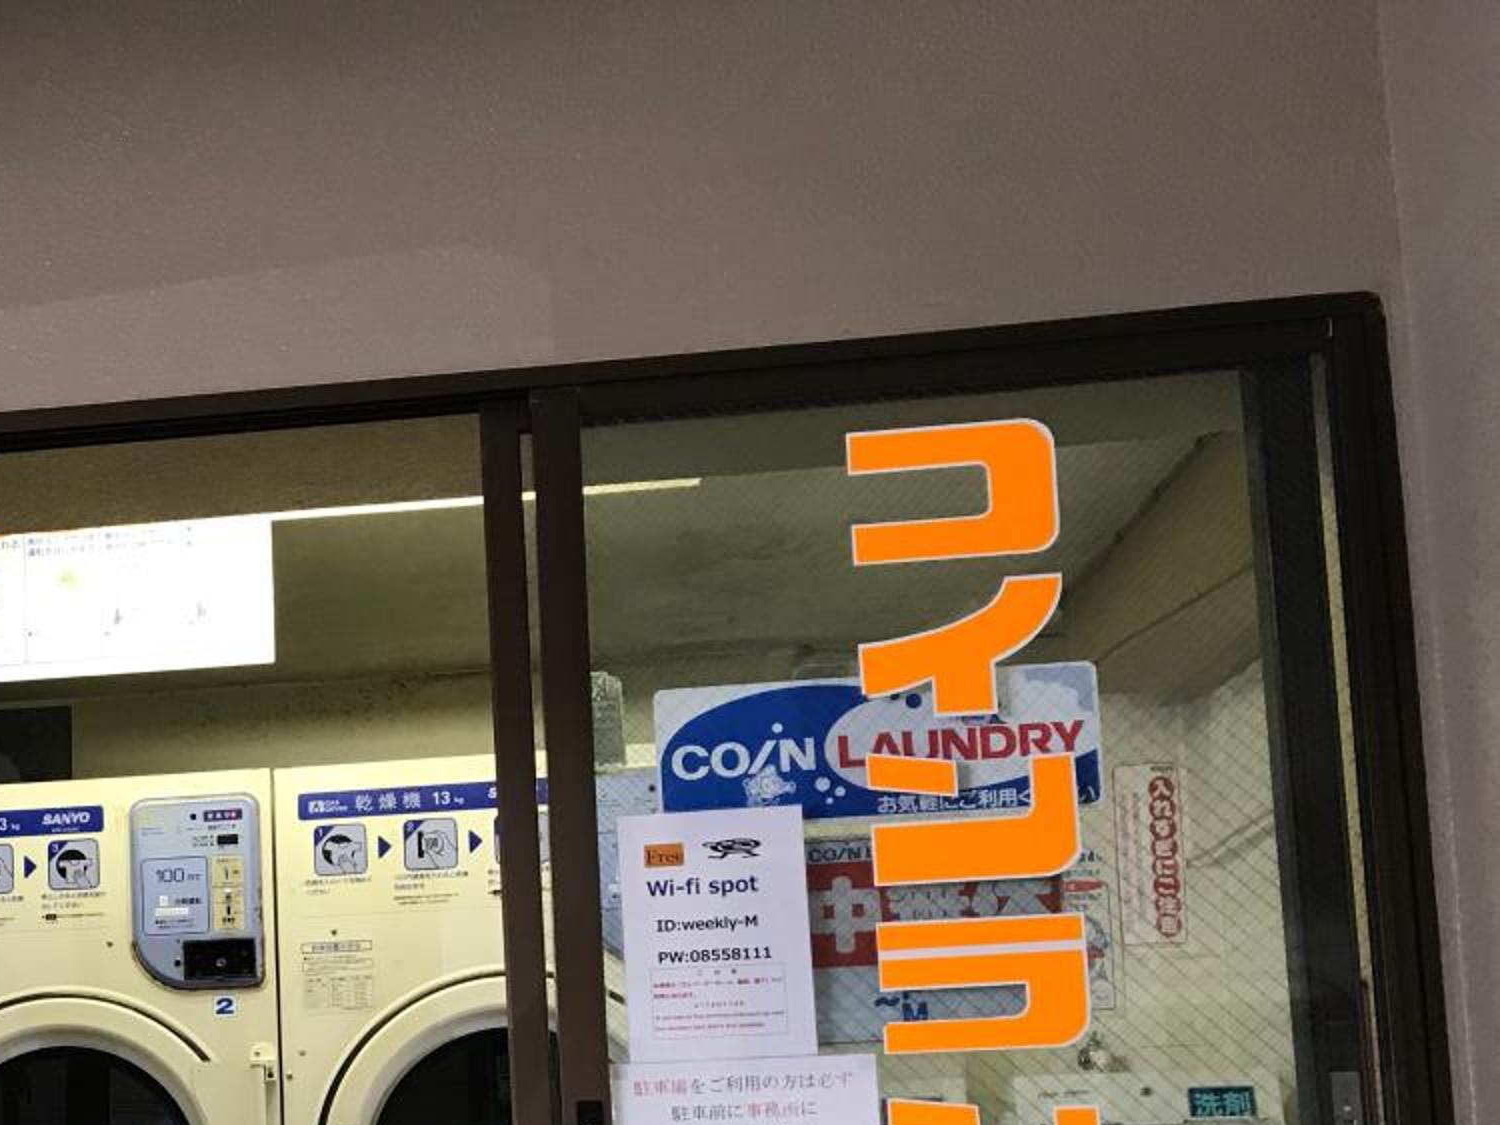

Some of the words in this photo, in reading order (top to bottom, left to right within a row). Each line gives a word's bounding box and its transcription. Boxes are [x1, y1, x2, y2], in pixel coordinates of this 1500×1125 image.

[837, 719, 1085, 771] LAUNDRY
[355, 792, 421, 812] 乾燥機
[432, 791, 450, 805] 13
[41, 811, 91, 826] SANYO
[647, 877, 700, 897] Wi-fi
[709, 876, 759, 897] spot
[656, 915, 759, 932] ID:weekly-M
[658, 946, 772, 964] PW:08558111
[216, 998, 235, 1015] 2
[634, 1071, 853, 1097] 駐車場をご利用の方は必ず
[671, 1100, 818, 1122] 駐車前に事務所に
